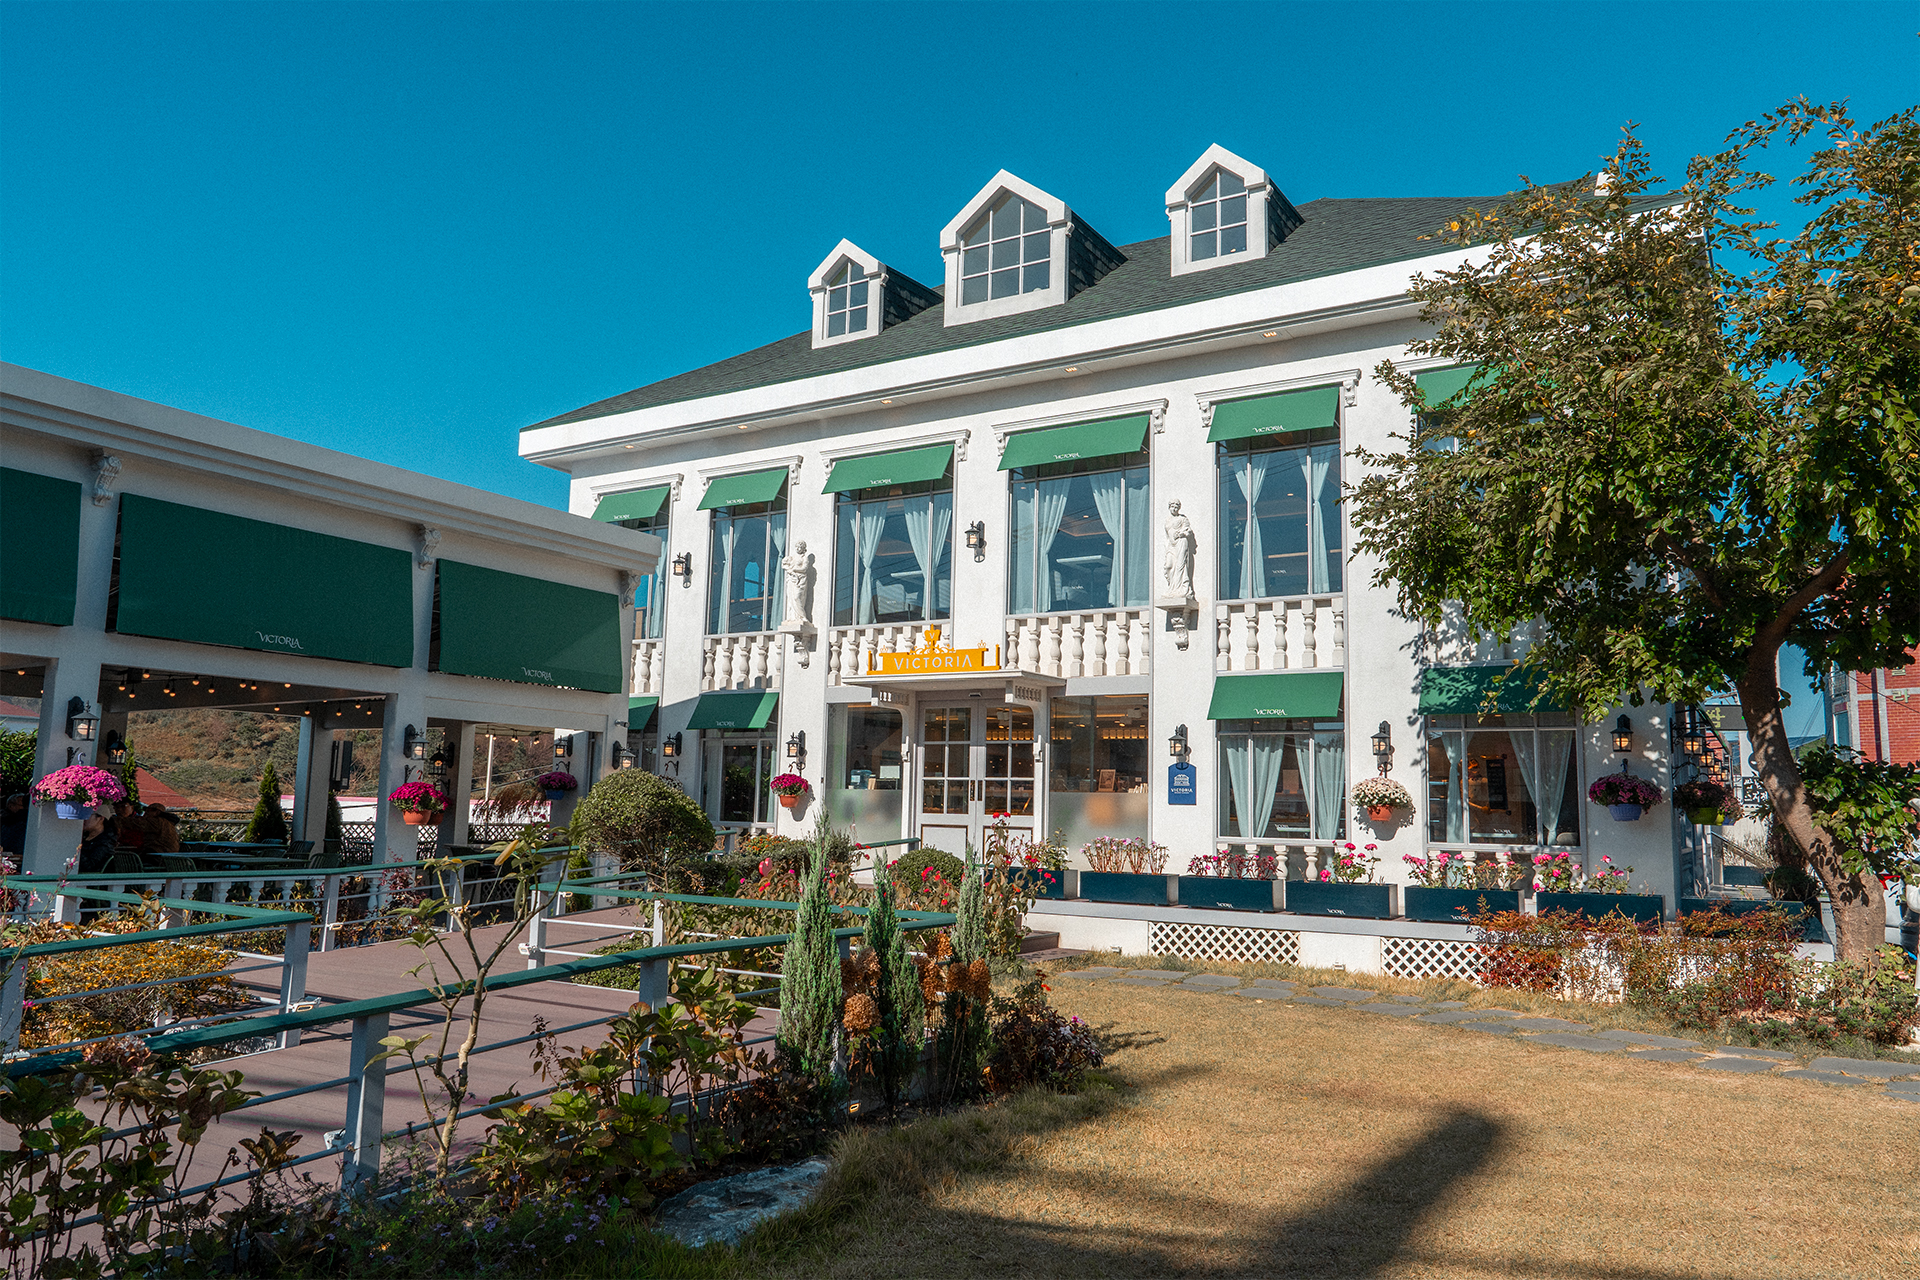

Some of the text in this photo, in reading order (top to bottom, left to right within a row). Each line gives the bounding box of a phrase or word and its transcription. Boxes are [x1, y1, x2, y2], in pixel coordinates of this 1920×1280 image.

[255, 630, 304, 650] VICTORIA
[893, 654, 973, 671] VICTORIA
[521, 666, 555, 682] VICTORIA
[1253, 707, 1288, 716] VICTORIA
